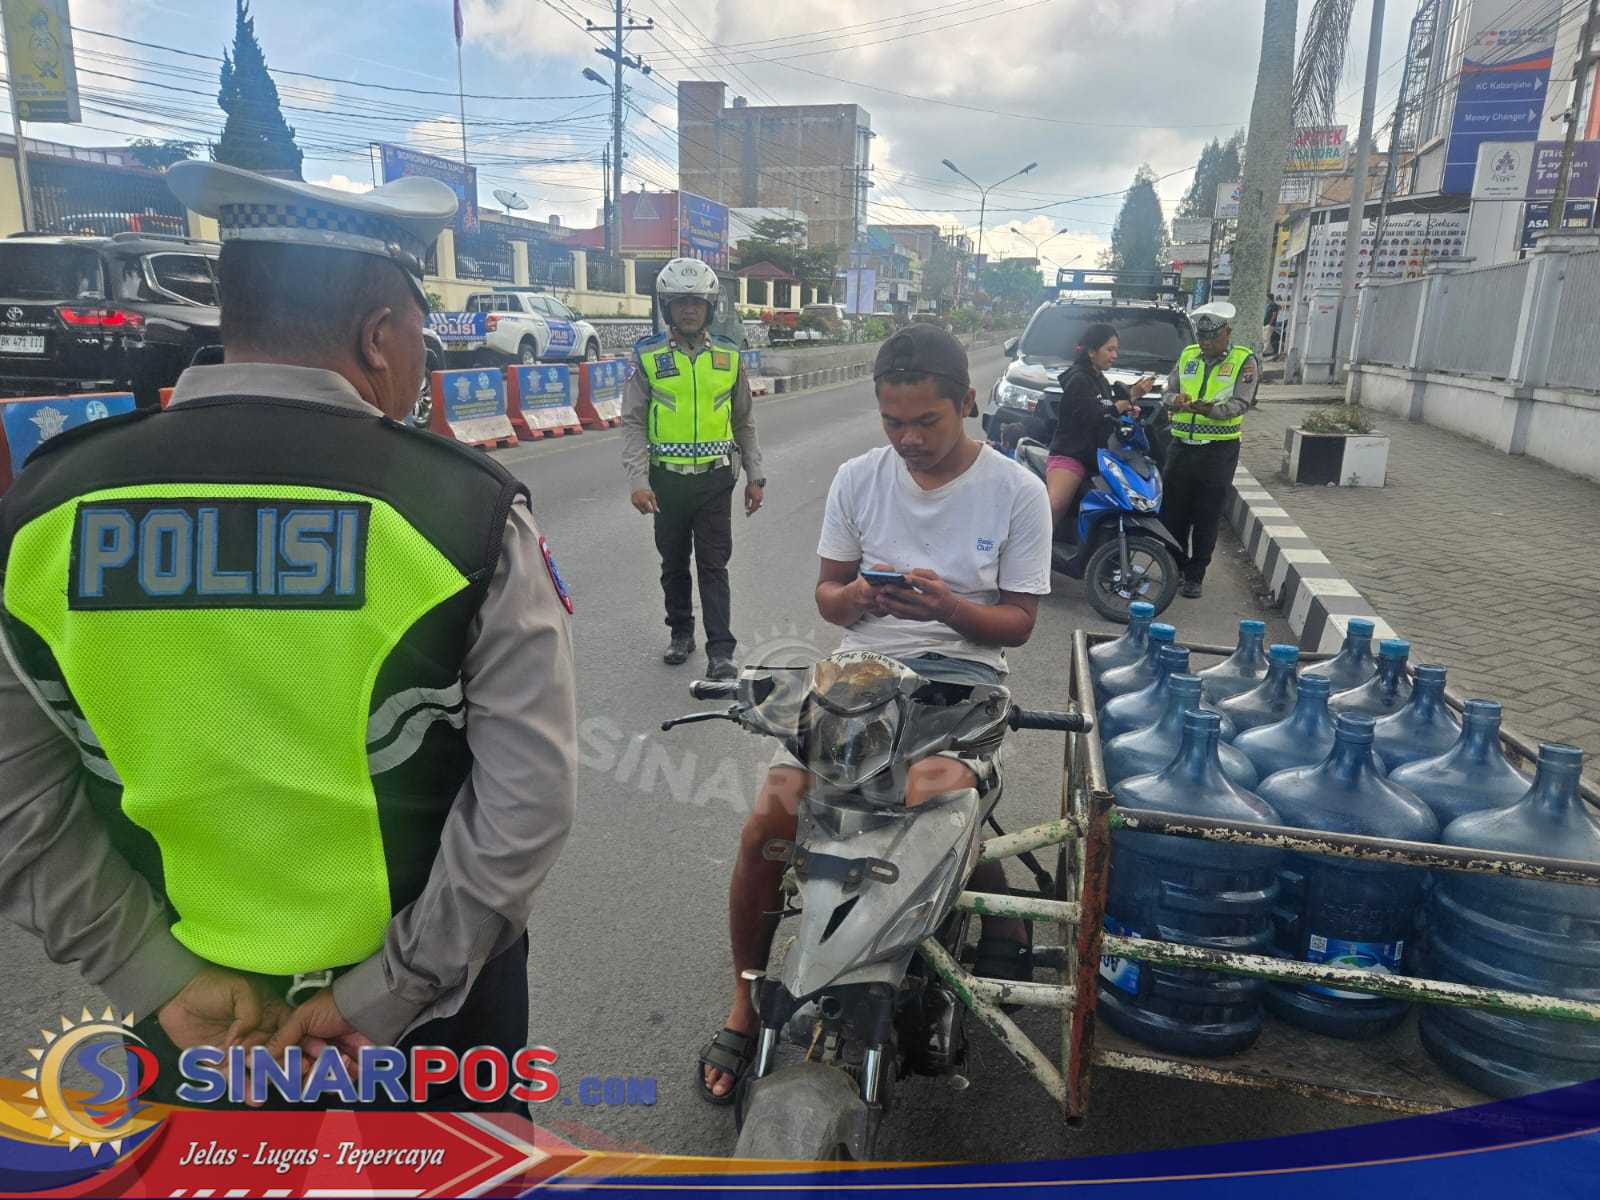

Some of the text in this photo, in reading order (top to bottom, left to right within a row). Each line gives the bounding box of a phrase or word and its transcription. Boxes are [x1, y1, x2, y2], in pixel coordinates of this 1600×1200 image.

[1464, 112, 1527, 122] Money Changer
[430, 323, 477, 335] POLISI
[78, 507, 360, 598] POLISI
